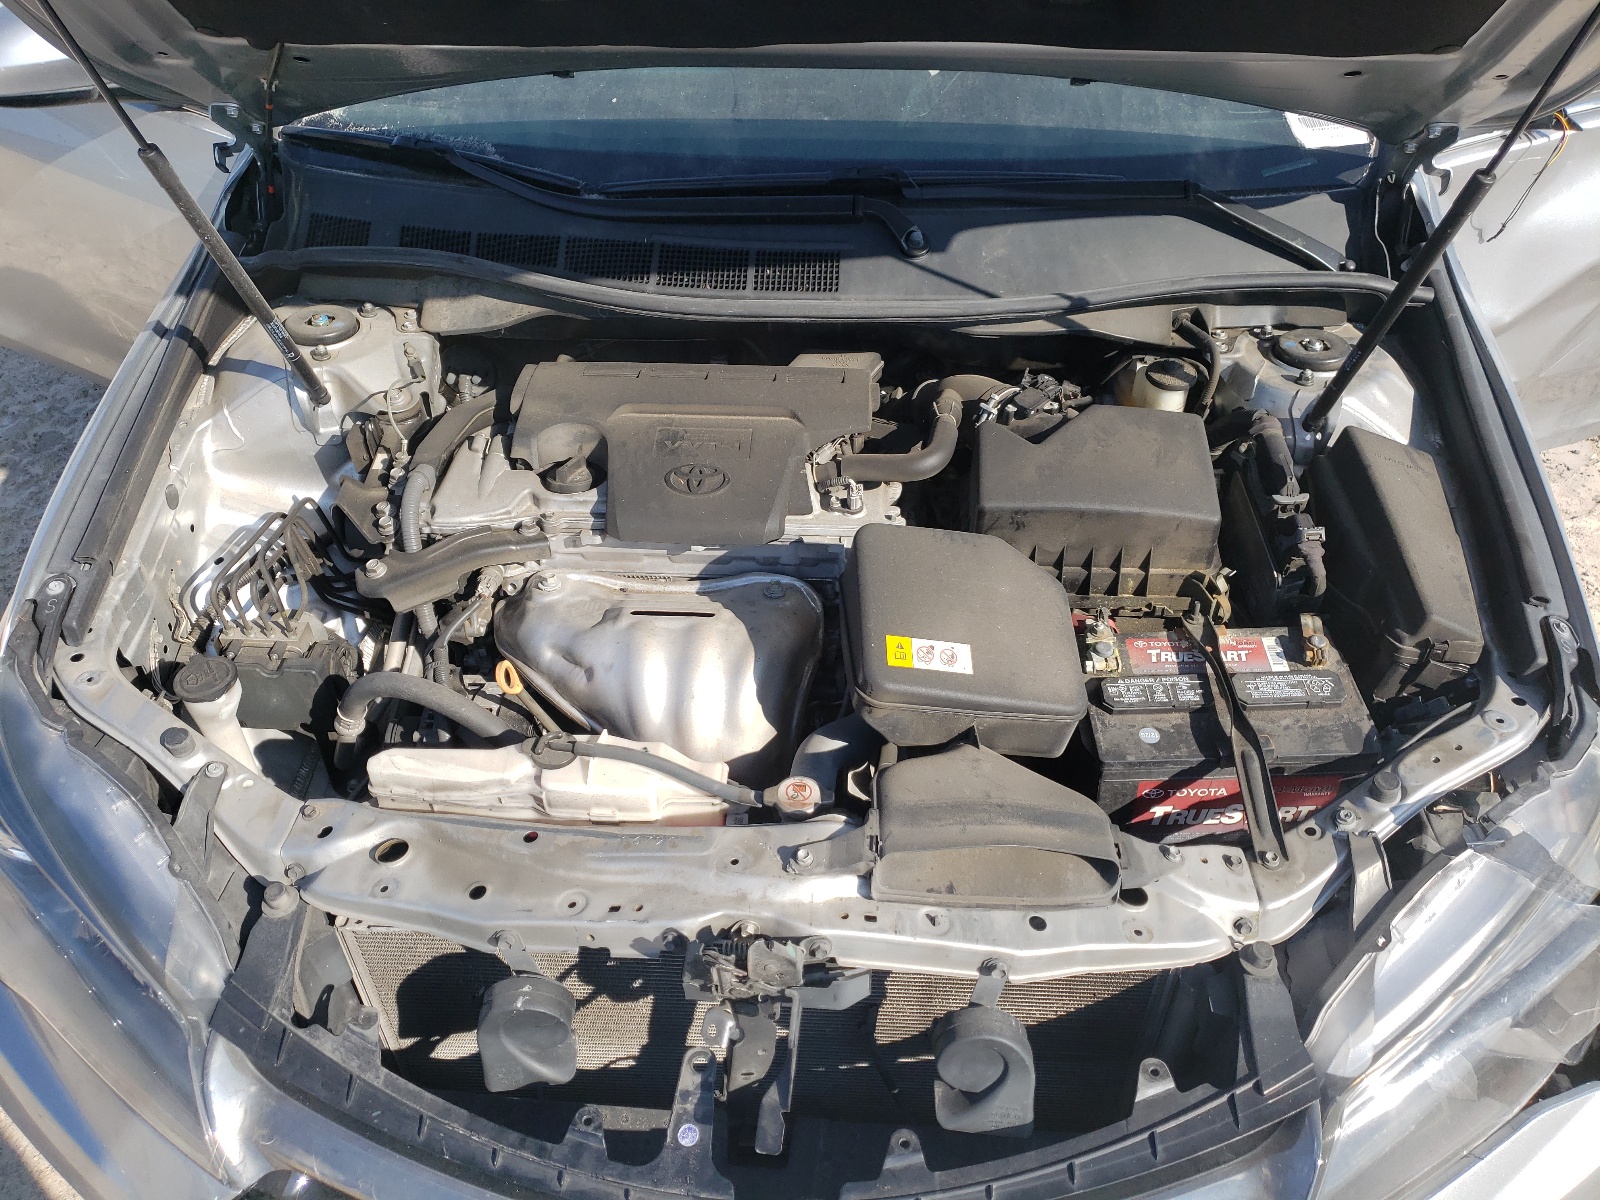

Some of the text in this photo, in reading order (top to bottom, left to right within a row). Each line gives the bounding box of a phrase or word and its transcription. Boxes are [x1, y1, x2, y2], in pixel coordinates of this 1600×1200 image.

[1147, 649, 1249, 663] TRUESRT
[1167, 787, 1228, 797] TOYOTA
[1150, 803, 1317, 826] TRUESRT
